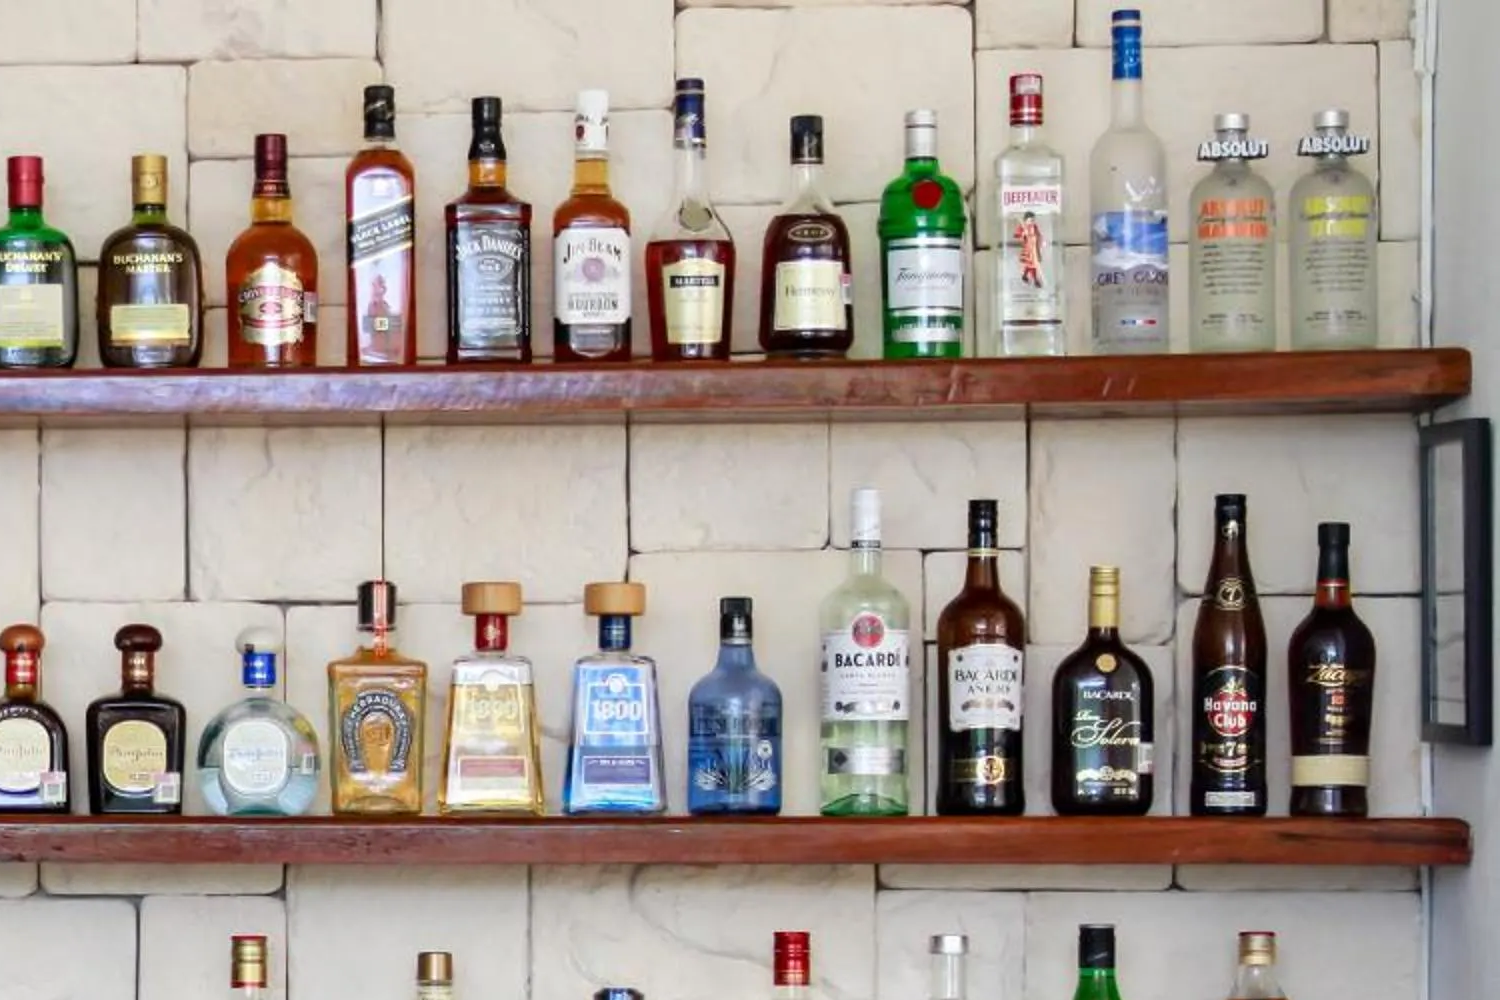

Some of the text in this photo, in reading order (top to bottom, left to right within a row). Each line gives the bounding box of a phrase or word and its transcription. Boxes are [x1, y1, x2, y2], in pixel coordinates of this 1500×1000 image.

[1200, 140, 1269, 158] ABSOLUT
[1300, 136, 1369, 153] ABSOLUT
[1003, 189, 1058, 206] BEEFEATER
[112, 253, 184, 265] BUCHANAN'S
[591, 700, 643, 721] 1800
[1204, 697, 1257, 712] Havana
[1214, 712, 1247, 729] Club
